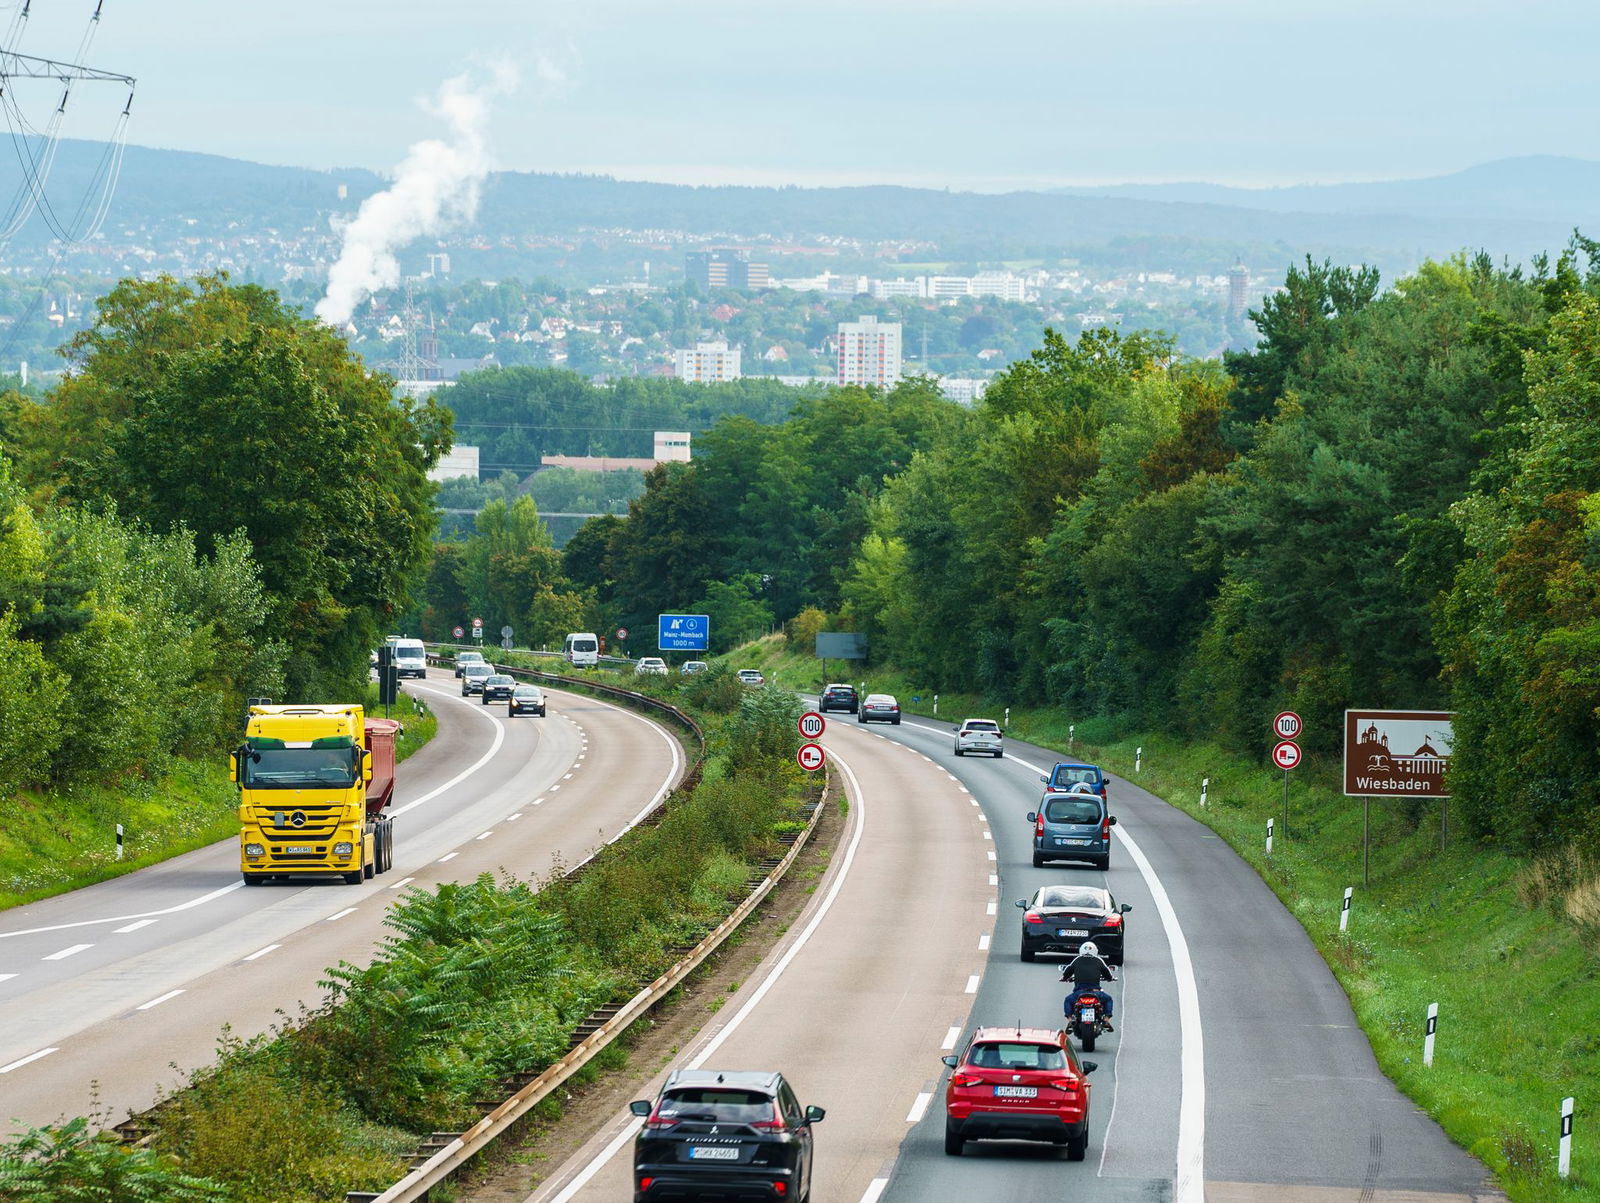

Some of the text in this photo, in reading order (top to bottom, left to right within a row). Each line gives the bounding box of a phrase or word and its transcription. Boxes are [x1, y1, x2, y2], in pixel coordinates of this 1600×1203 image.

[672, 639, 688, 647] 1000
[803, 719, 820, 732] 100
[1280, 719, 1297, 732] 100
[1356, 776, 1431, 790] Wiesbaden
